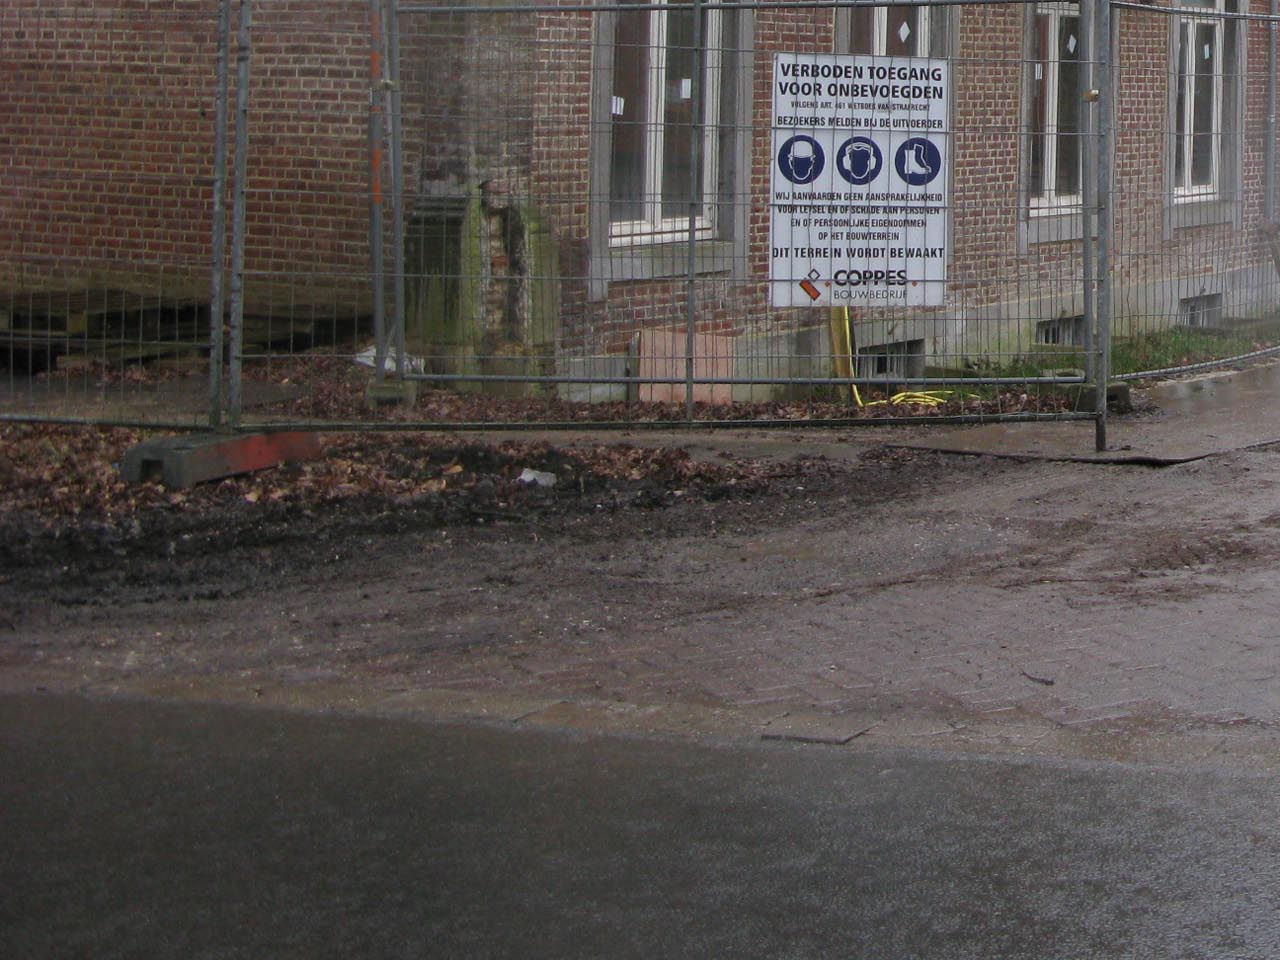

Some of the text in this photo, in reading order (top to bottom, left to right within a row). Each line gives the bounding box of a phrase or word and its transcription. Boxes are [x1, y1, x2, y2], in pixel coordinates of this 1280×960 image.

[781, 63, 942, 82] VERBODEN TOEGANG
[778, 82, 943, 99] VOOR ONBEVOEGDEN
[777, 116, 943, 129] BEZOEKERS MELDEN BIJ DE UITVOERDER
[775, 192, 943, 202] WIJ AANVAARDEN GEEN AANSPRAKELIJKHEID
[777, 205, 798, 214] VOOR
[828, 206, 838, 214] EN
[839, 206, 849, 214] OF
[851, 206, 880, 214] SCHADE
[883, 206, 898, 214] AAN
[901, 207, 940, 215] PERSONEN
[791, 219, 927, 228] EN OF PERSOONLIJKE EIGENDOMMEN
[818, 232, 900, 241] OP HET BOUWTERREIN
[773, 248, 945, 258] DIT TERREIN WORDT BEWAAKT
[834, 269, 907, 286] COPPES
[834, 290, 907, 300] BOUWBEDRIJF
